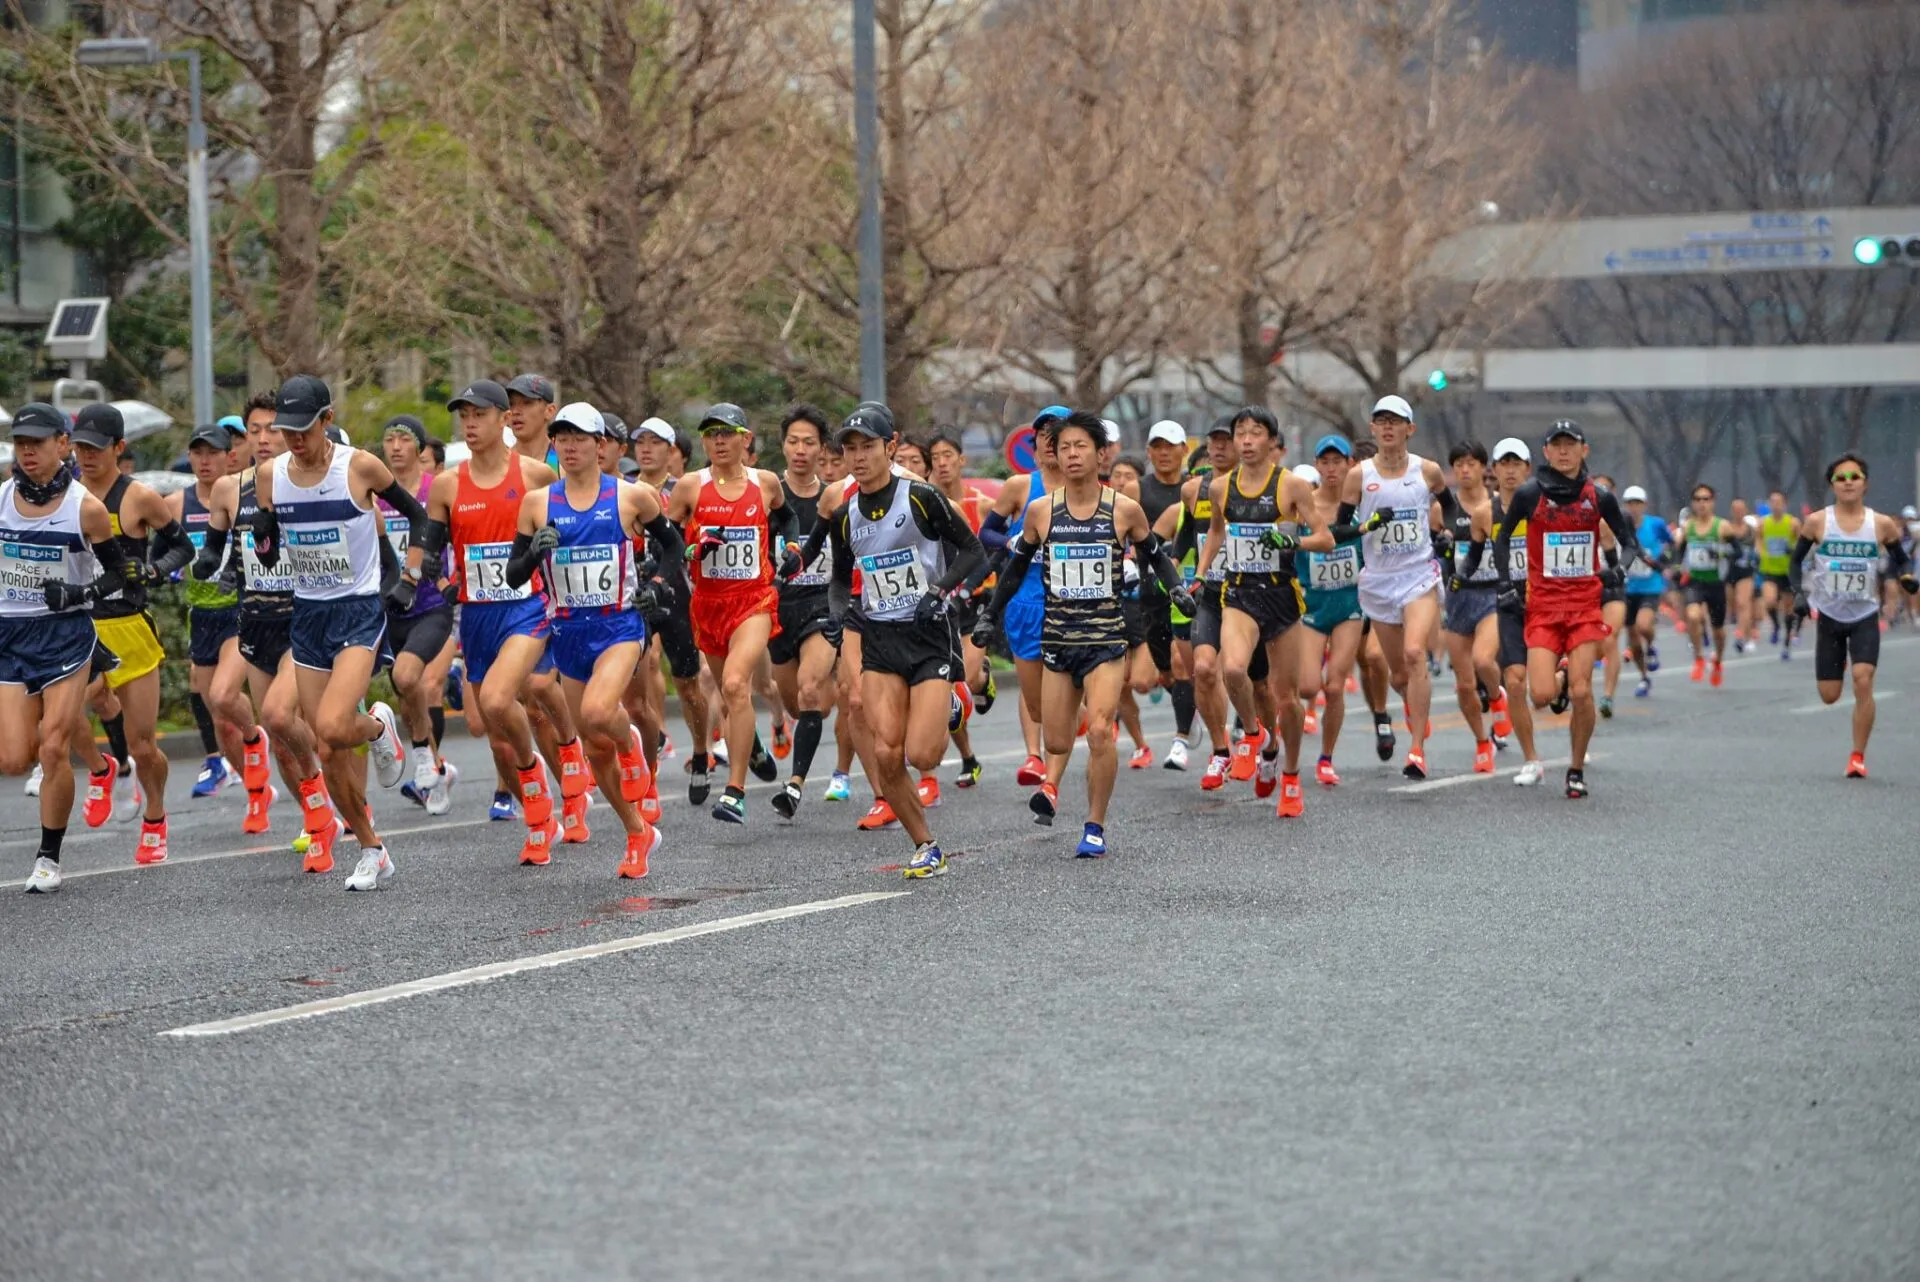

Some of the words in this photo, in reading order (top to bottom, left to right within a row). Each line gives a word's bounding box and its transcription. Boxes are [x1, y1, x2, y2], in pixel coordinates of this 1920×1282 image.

[854, 525, 876, 540] JFE
[1052, 525, 1091, 533] Nishitetsu
[1381, 521, 1418, 544] 203
[297, 550, 321, 560] PACE
[324, 549, 331, 559] 5
[484, 547, 512, 557] 東京メト
[711, 543, 754, 568] 108
[1234, 539, 1272, 561] 136
[1554, 547, 1587, 567] 141
[1827, 543, 1872, 557] 名古屋大学
[15, 562, 41, 576] PACE
[45, 566, 51, 576] 6
[250, 563, 293, 578] FUKUD
[477, 562, 505, 588] 13
[1061, 561, 1106, 587] 119
[1318, 560, 1354, 582] 208
[0, 570, 65, 590] YOROIZ
[564, 565, 612, 594] 116
[872, 565, 919, 599] 154
[1834, 573, 1866, 592] 179
[17, 591, 46, 602] STAR
